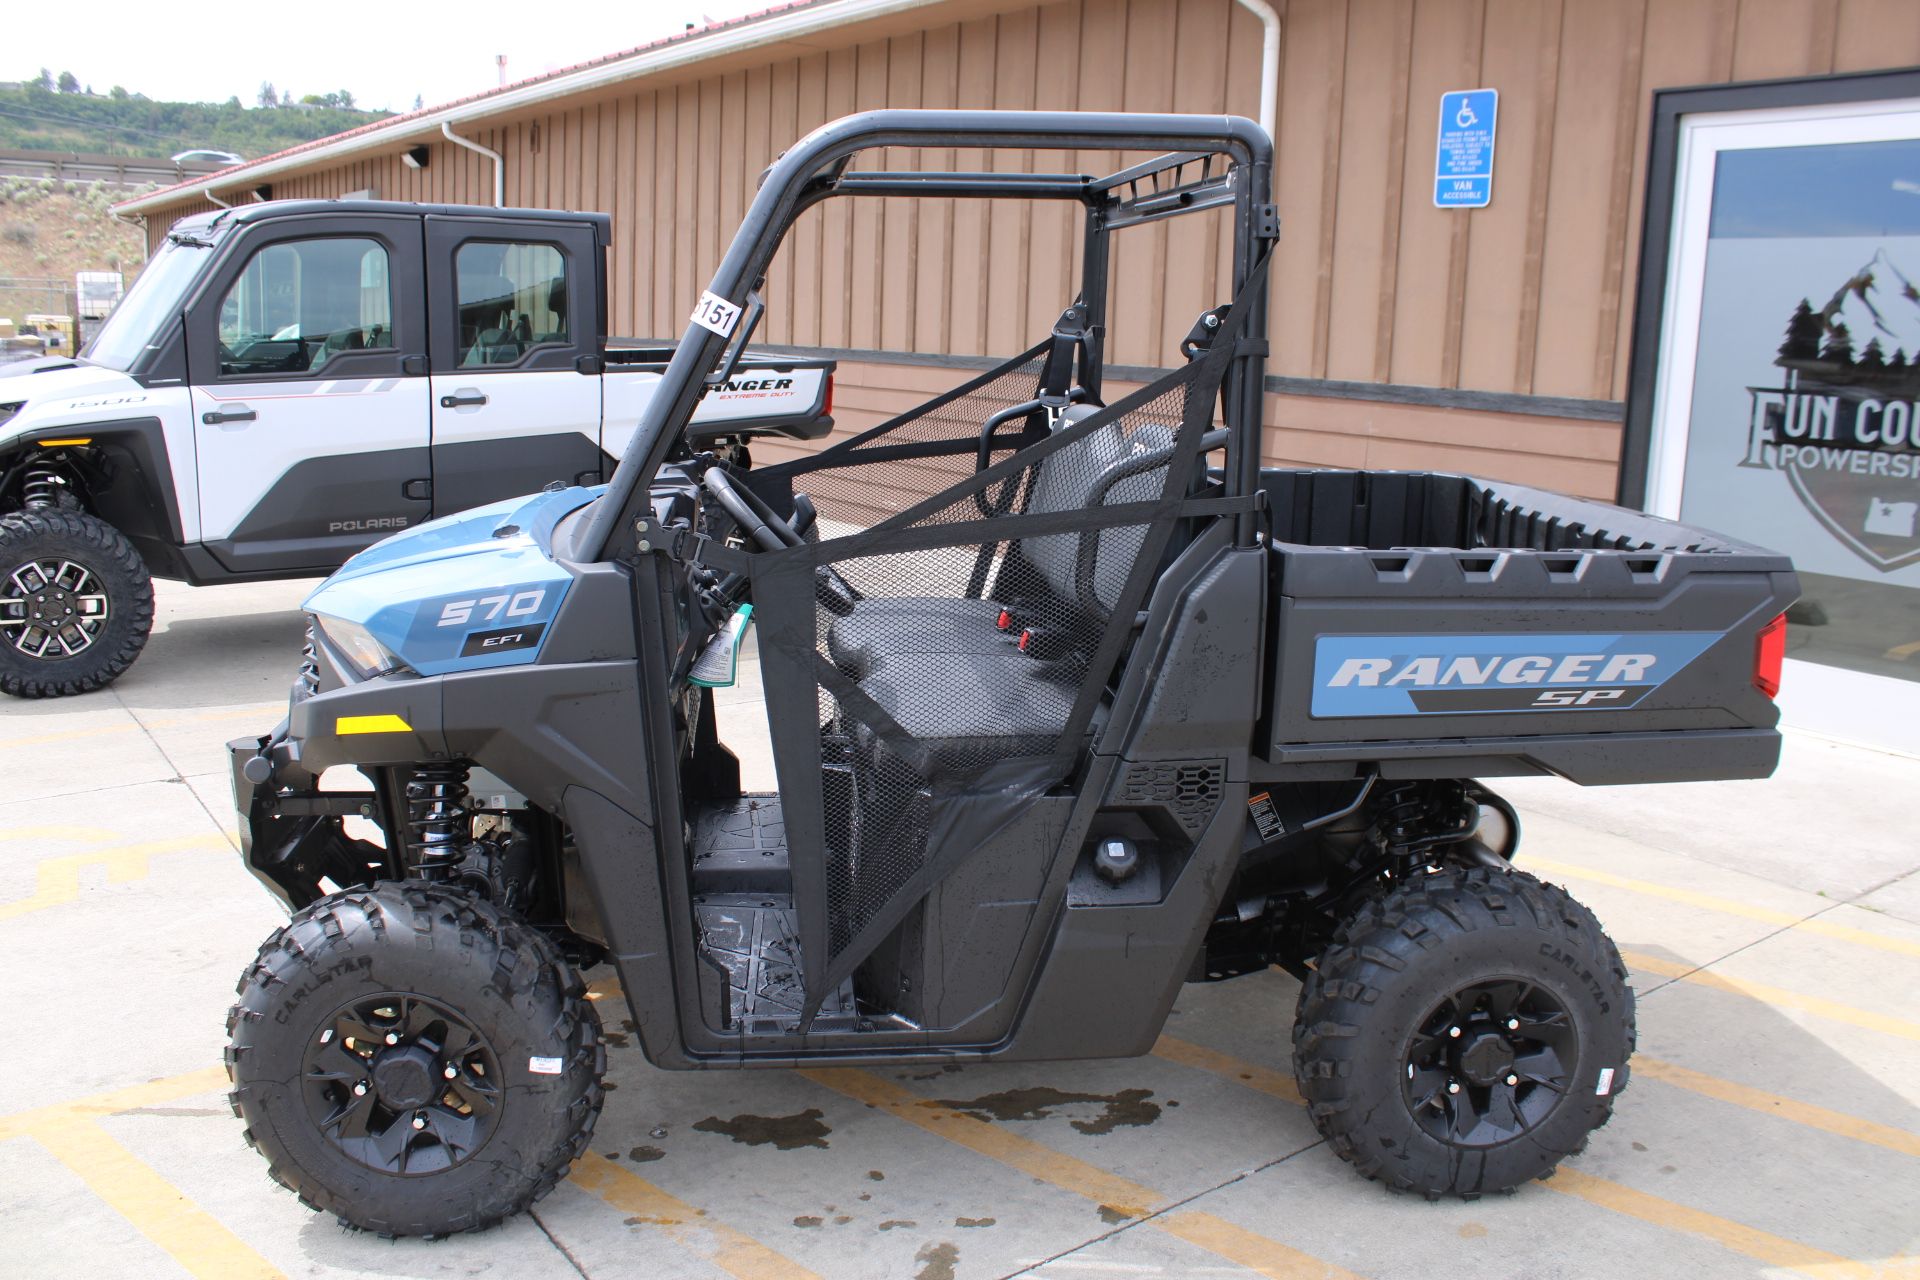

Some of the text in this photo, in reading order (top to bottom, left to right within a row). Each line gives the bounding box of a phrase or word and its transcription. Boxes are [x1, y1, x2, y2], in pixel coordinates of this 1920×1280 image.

[1442, 191, 1482, 199] ACCESSIBLE
[1453, 180, 1473, 191] VAN
[694, 297, 735, 330] 151
[1746, 388, 1838, 467] FUN
[329, 516, 408, 532] POLARIS
[436, 589, 546, 628] 570
[482, 633, 523, 647] EFI
[1327, 654, 1656, 687] RANGER
[1531, 689, 1626, 706] SP
[275, 954, 373, 1025] CARLSTAR
[1537, 942, 1611, 1016] CARLSTAR
